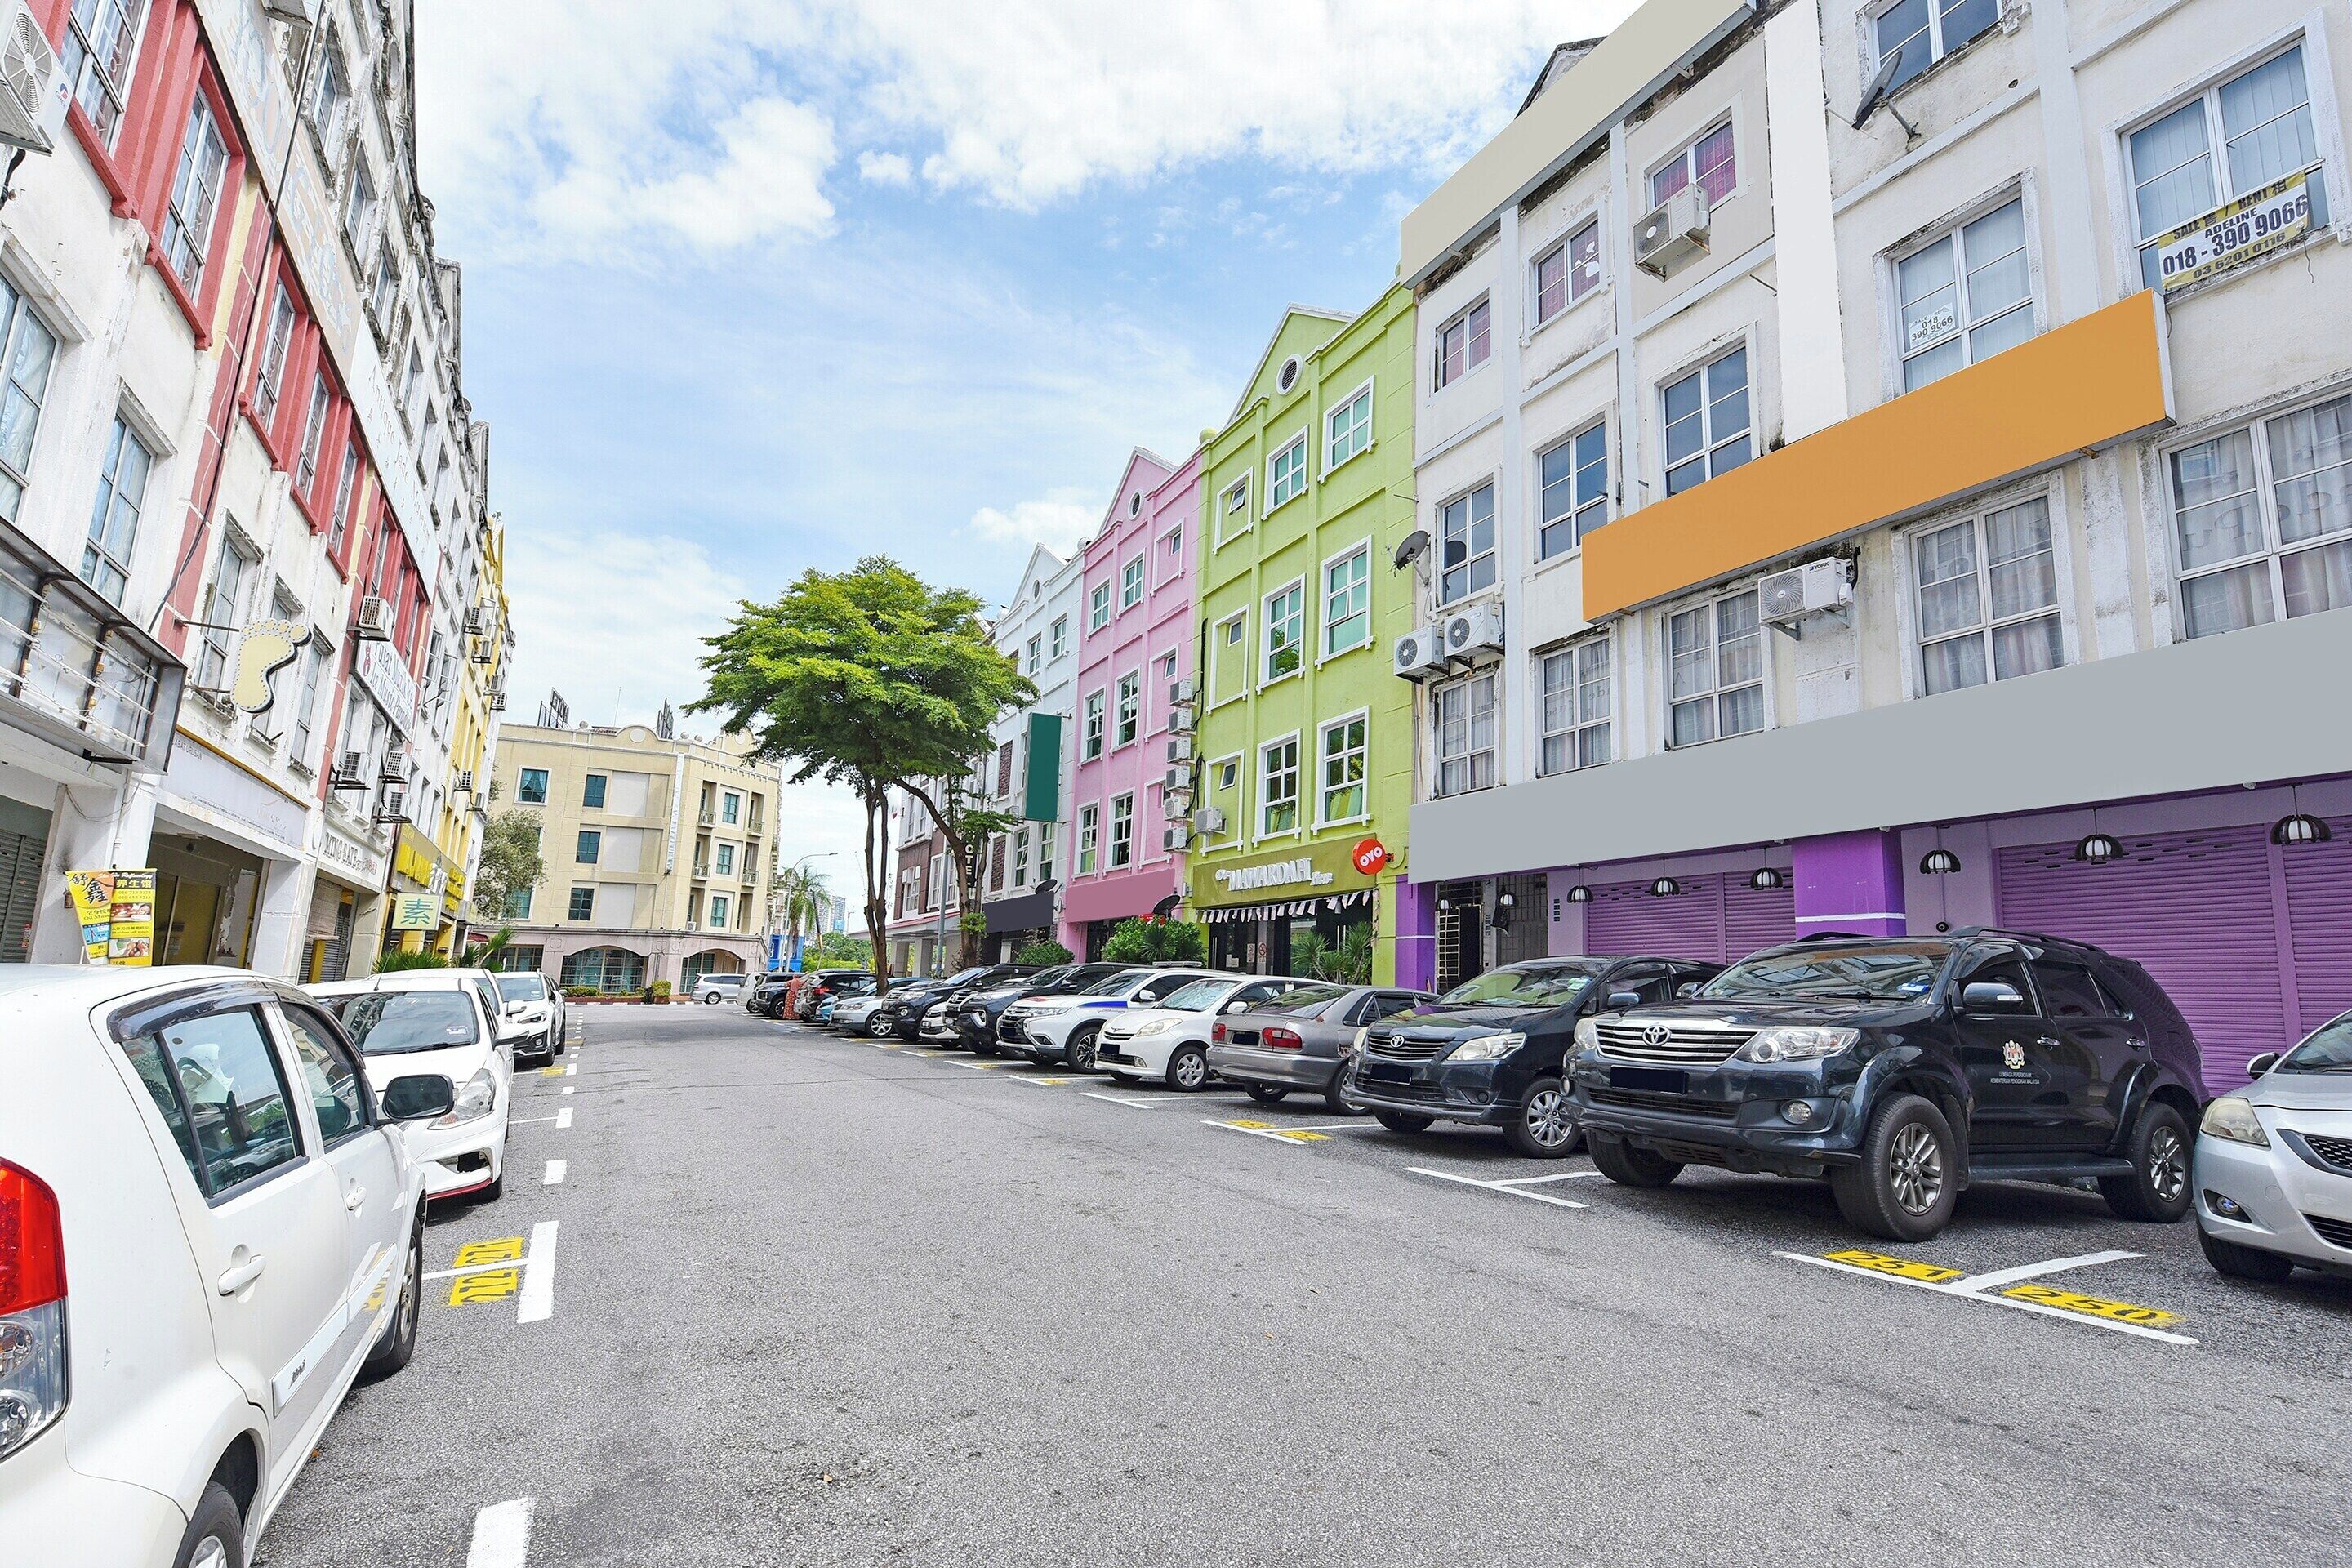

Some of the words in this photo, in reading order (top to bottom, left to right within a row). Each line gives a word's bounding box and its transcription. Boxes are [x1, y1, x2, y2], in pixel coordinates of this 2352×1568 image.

[2173, 219, 2201, 240] SALE
[2271, 179, 2287, 196] 租
[2204, 207, 2258, 238] ADELINE
[2163, 246, 2197, 276] 018
[2212, 222, 2250, 256] 390
[2254, 194, 2309, 237] 9066
[2193, 265, 2212, 278] 03
[2215, 249, 2250, 268] 6201
[2252, 232, 2286, 253] 0116
[1911, 328, 1928, 341] 390
[1931, 315, 1953, 332] 9066
[1922, 316, 1938, 328] 018
[1814, 561, 1829, 570] YORK
[1360, 846, 1383, 866] OYO
[116, 879, 152, 888] 养生馆
[1227, 858, 1312, 892] MAWARDAH
[400, 898, 434, 925] 素
[1837, 1252, 1945, 1277] 251
[2012, 1289, 2159, 1320] 250
